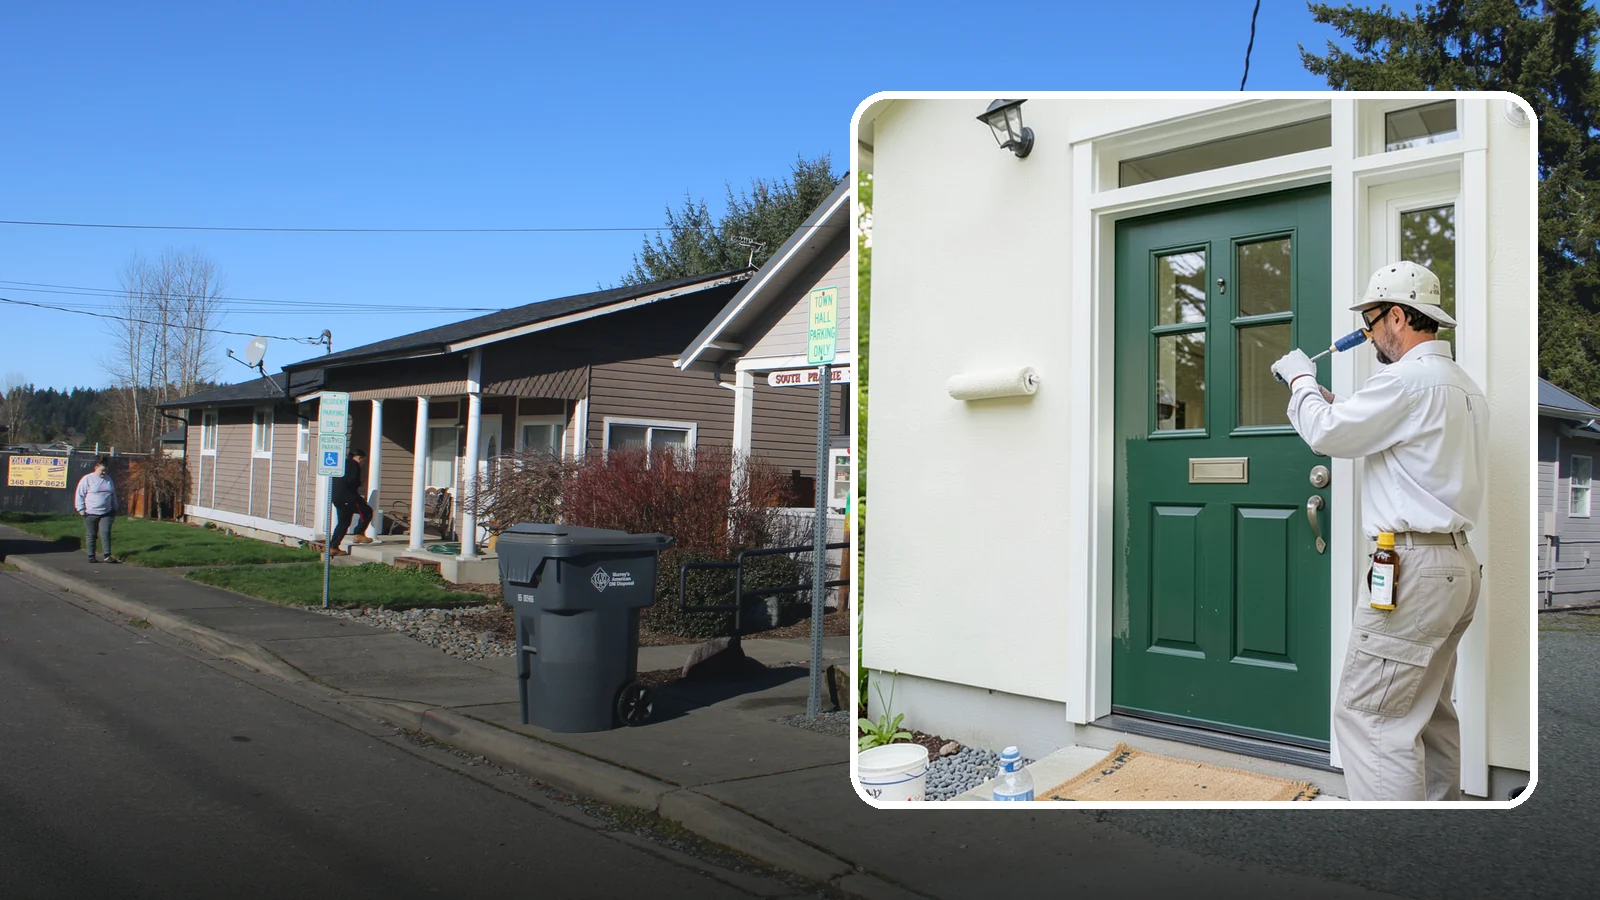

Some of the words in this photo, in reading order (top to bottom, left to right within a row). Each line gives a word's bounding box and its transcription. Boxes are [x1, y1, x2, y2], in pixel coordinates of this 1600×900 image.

[815, 294, 832, 308] TOWN
[815, 311, 831, 324] HALL
[810, 326, 836, 340] PARKING
[814, 344, 830, 357] ONLY
[775, 373, 801, 384] SOUTH
